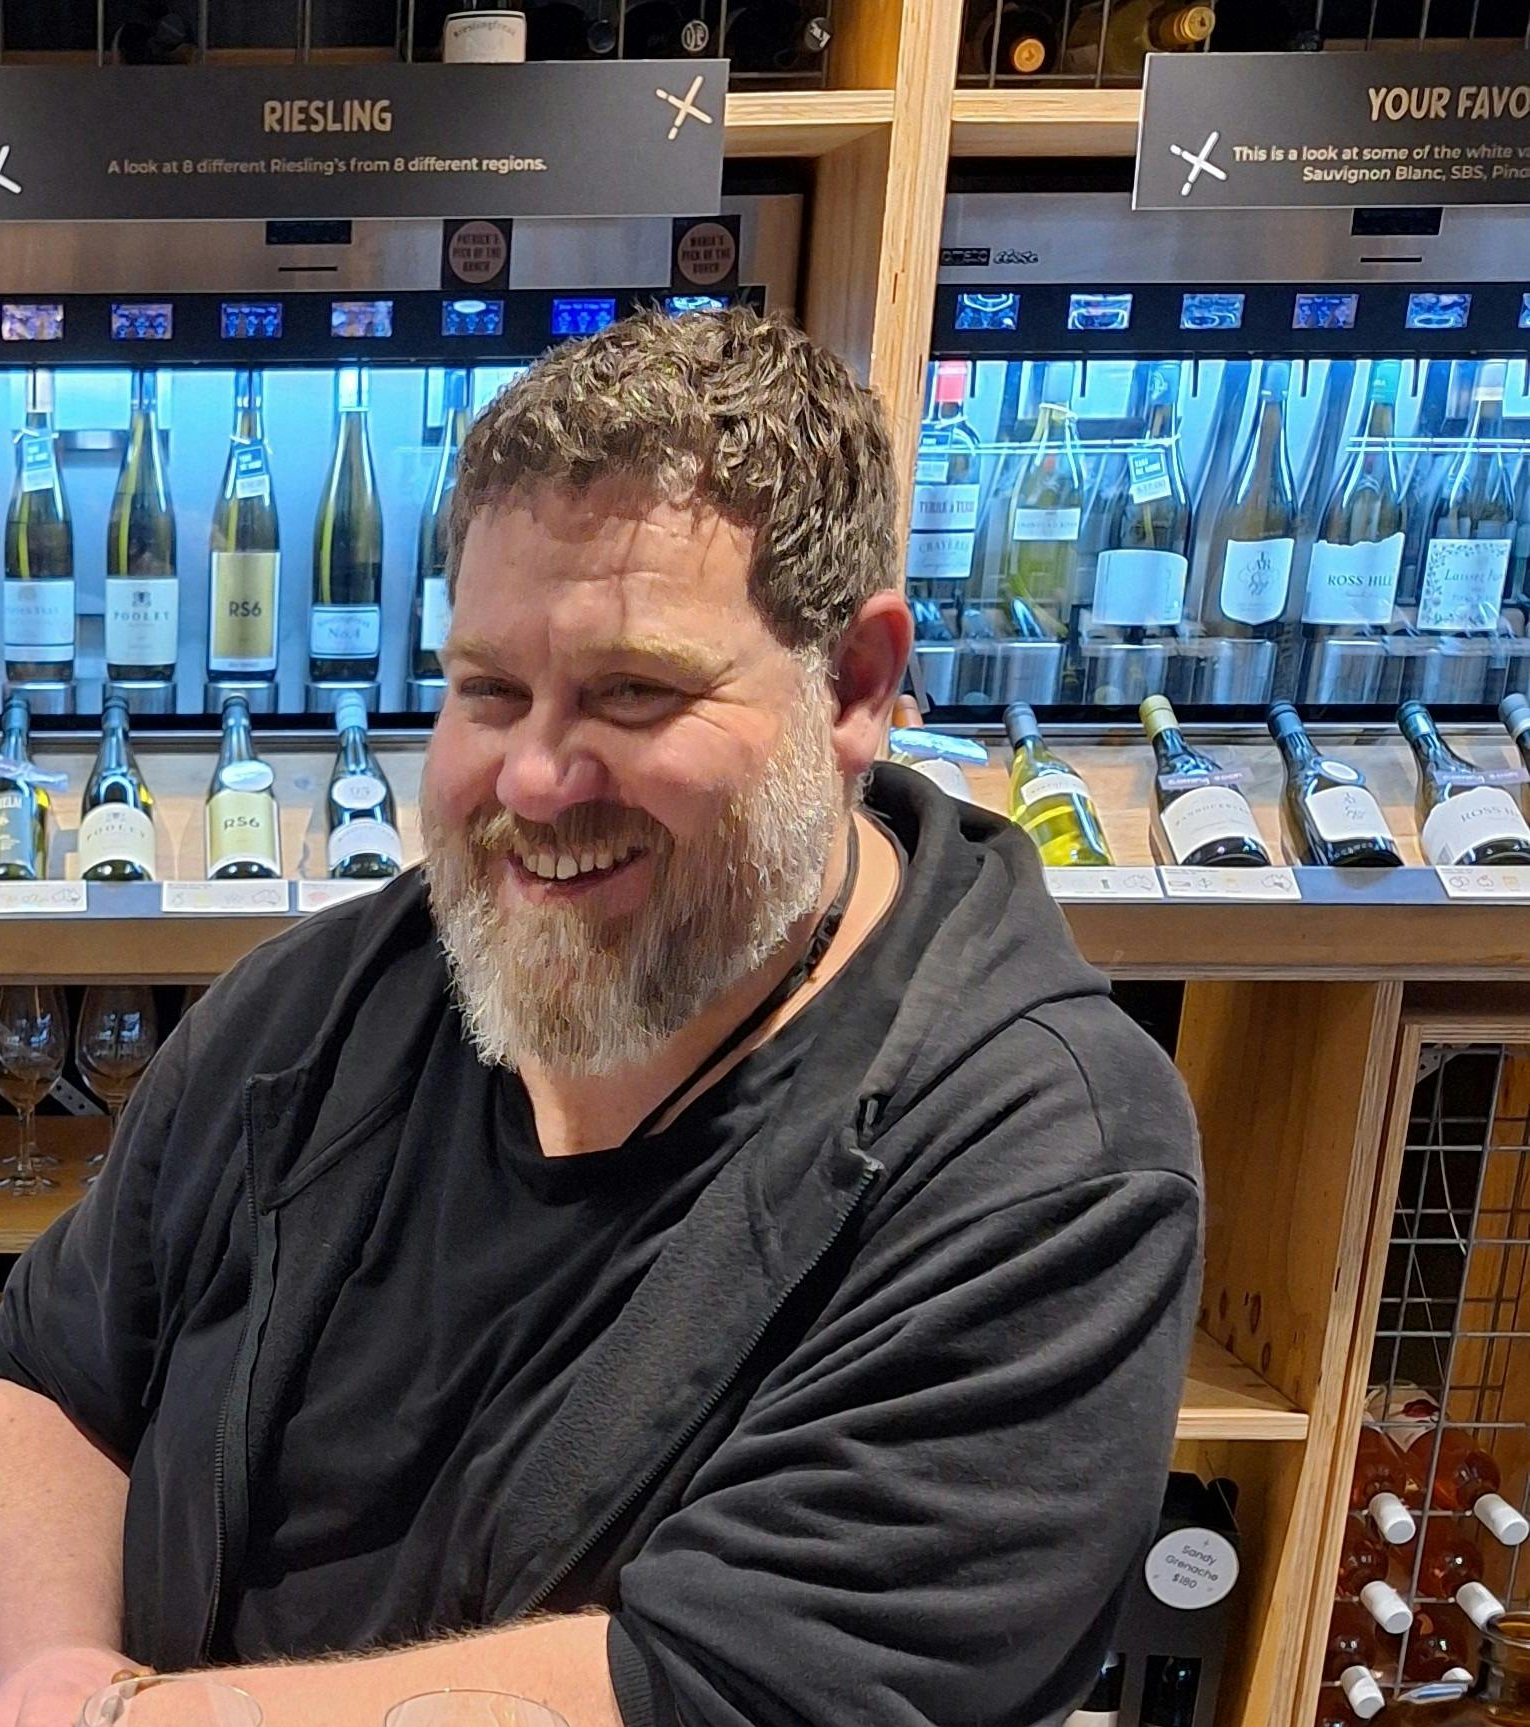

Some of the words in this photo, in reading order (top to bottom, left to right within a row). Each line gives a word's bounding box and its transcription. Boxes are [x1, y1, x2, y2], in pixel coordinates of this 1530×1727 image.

[1369, 87, 1451, 121] YOUR
[1457, 86, 1530, 119] FAVO
[263, 99, 392, 133] RIESLING
[1233, 146, 1267, 161] This
[1270, 146, 1285, 161] is
[1288, 150, 1298, 161] a
[1302, 146, 1339, 161] look
[1342, 147, 1359, 161] at
[1362, 149, 1409, 161] some
[1413, 145, 1431, 159] of
[1433, 145, 1462, 159] the
[1466, 144, 1513, 158] white
[107, 160, 121, 174] A
[124, 159, 159, 174] look
[162, 161, 178, 174] at
[182, 160, 193, 174] 8
[196, 158, 266, 174] different
[270, 157, 347, 176] Riesling's
[350, 157, 390, 172] from
[393, 157, 405, 172] 8
[408, 156, 479, 172] different
[482, 155, 548, 174] regions.
[1303, 165, 1390, 184] Sauvignon
[1395, 165, 1446, 181] Blanc,
[1450, 165, 1487, 182] SBS,
[1327, 574, 1364, 586] ROSS
[228, 600, 263, 618] RS6
[1461, 805, 1501, 822] ROSS
[223, 816, 260, 831] RS6
[1181, 1545, 1217, 1567] Sandy
[1165, 1554, 1219, 1582] Grenache
[1172, 1573, 1198, 1589] $180
